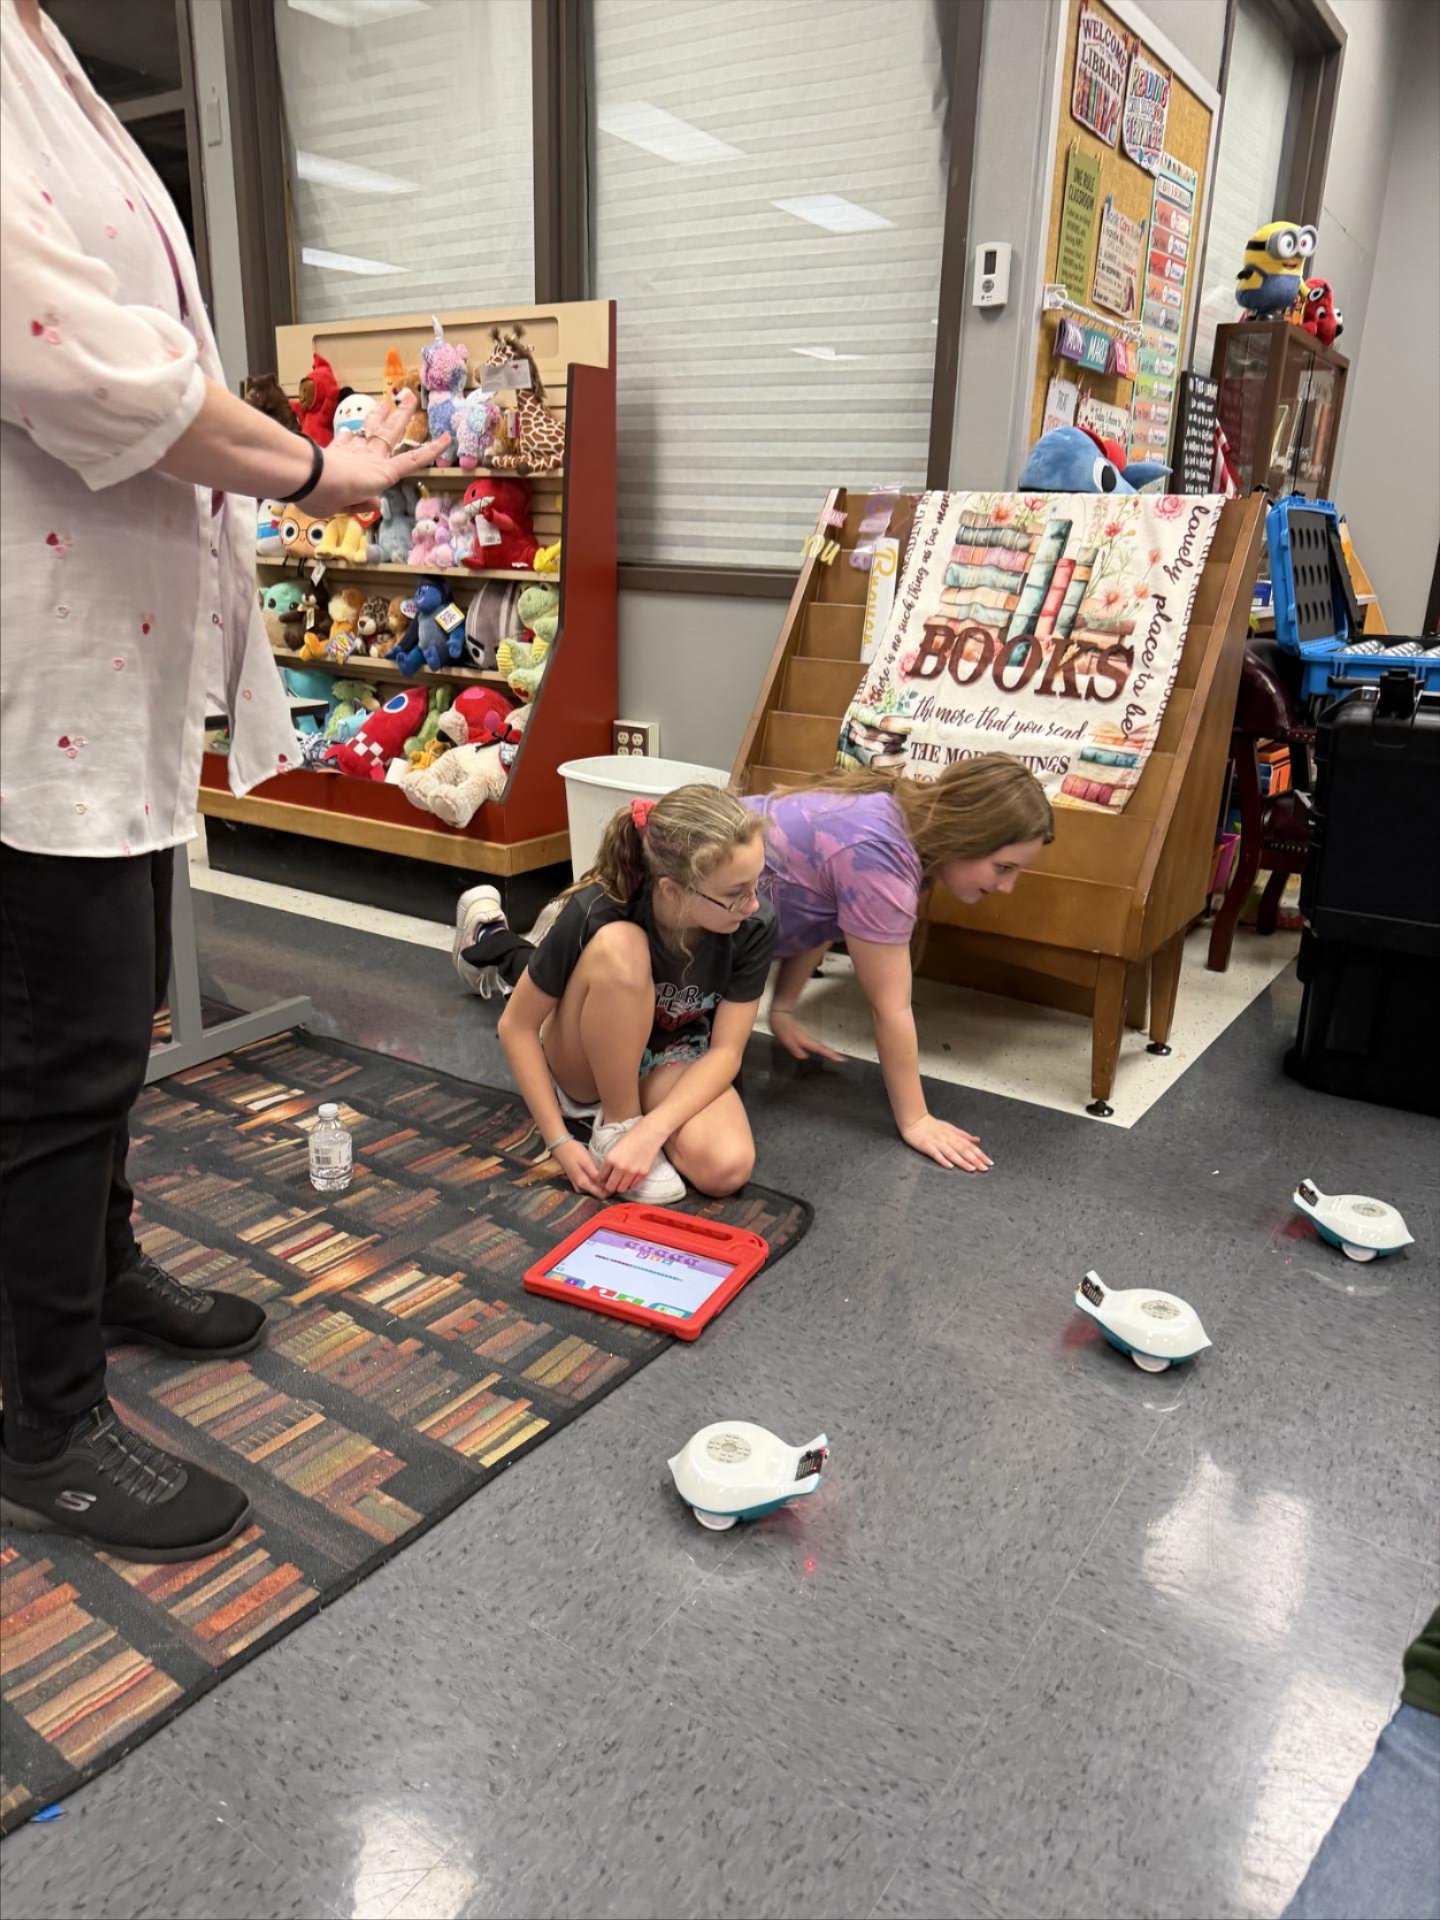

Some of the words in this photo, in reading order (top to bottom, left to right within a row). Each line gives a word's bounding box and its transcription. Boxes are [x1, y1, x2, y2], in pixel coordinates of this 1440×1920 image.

[1083, 18, 1127, 74] WELCOME
[1081, 43, 1123, 94] LIBRARY
[924, 527, 939, 546] too
[1162, 505, 1210, 585] lovely
[922, 549, 932, 563] as
[907, 566, 930, 601] thing
[898, 598, 915, 634] such
[1142, 593, 1172, 669] place
[885, 653, 896, 665] is
[892, 634, 902, 652] no
[906, 624, 1133, 703] BOOKS
[869, 667, 890, 704] there
[1132, 672, 1155, 698] to
[935, 707, 975, 726] more
[975, 706, 1017, 731] that
[1008, 720, 1045, 740] you
[1045, 720, 1088, 740] read
[1121, 703, 1147, 739] be
